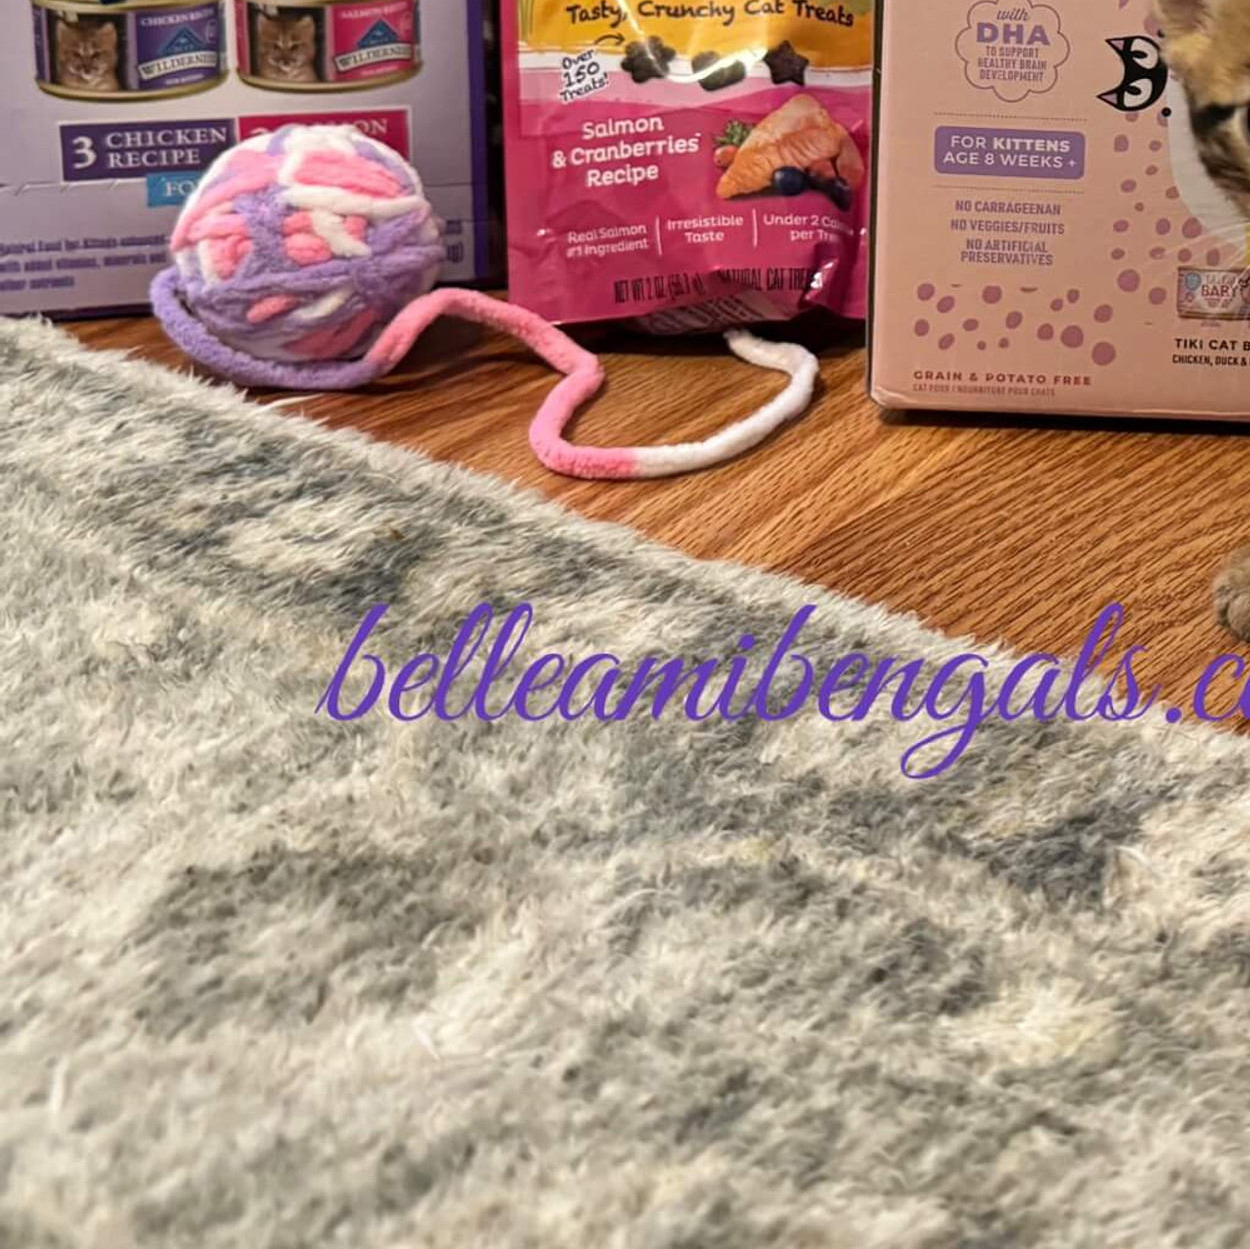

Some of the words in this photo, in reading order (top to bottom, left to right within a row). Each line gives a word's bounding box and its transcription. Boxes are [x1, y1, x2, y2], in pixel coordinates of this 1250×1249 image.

[996, 7, 1029, 22] with
[976, 22, 1051, 46] DHA
[562, 49, 594, 70] Over
[999, 47, 1039, 59] SUPPORT
[978, 57, 1017, 69] HEALTHY
[564, 61, 600, 88] 150
[980, 69, 1044, 82] DEVELOPMENT
[560, 72, 609, 102] Treats!
[583, 116, 664, 141] Salmon
[105, 127, 228, 150] CHICKEN
[951, 135, 986, 151] FOR
[993, 136, 1071, 153] KITTENS
[73, 136, 97, 169] 3
[107, 148, 201, 170] RECIPE
[552, 151, 567, 169] &
[571, 135, 700, 166] Cranberries
[943, 151, 979, 166] AGE
[984, 152, 995, 167] 8
[999, 153, 1063, 169] WEEKS
[587, 164, 659, 189] Recipe
[164, 180, 200, 197] FO
[955, 200, 972, 213] NO
[974, 200, 1061, 217] CARRAGEENAN
[667, 214, 744, 230] Irresistible
[763, 213, 808, 226] Under
[811, 214, 819, 226] 2
[950, 219, 967, 232] NO
[970, 219, 1065, 236] VEGGIES/FRUITS
[567, 231, 598, 244] Real
[600, 224, 647, 240] Salmon
[685, 230, 724, 243] Taste
[790, 230, 814, 242] per
[585, 239, 648, 257] Ingredient
[966, 238, 982, 252] NO
[984, 239, 1048, 254] ARTIFICIAL
[961, 251, 1053, 267] PRESERVATIVES
[1174, 338, 1203, 350] TIKI
[1208, 339, 1238, 352] CAT
[1172, 353, 1213, 367] CHICKEN,
[1215, 355, 1239, 366] DUCK
[913, 370, 962, 382] GRAIN
[969, 371, 978, 382] &
[986, 372, 1047, 385] POTATO
[1053, 374, 1092, 387] FREE
